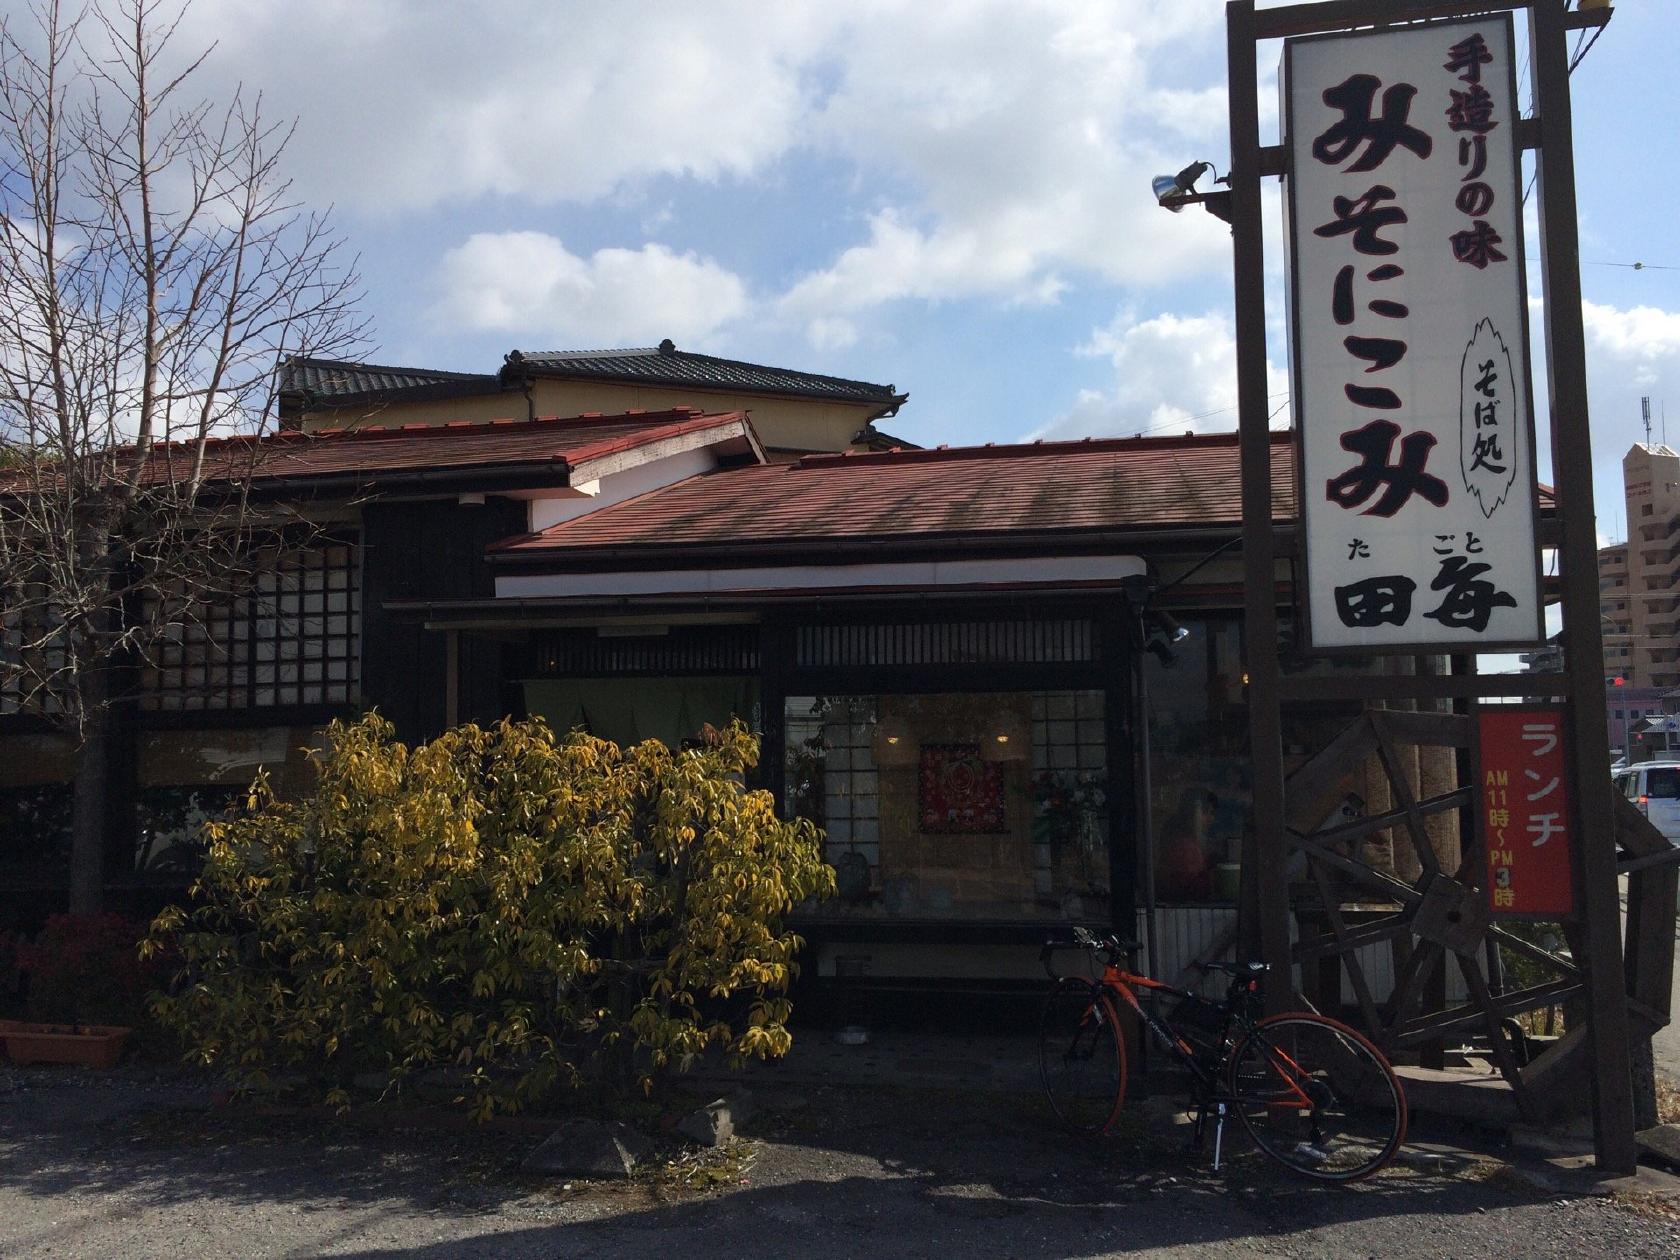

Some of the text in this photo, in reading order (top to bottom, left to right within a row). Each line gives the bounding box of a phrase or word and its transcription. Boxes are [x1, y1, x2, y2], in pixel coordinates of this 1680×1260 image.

[1443, 33, 1507, 269] 手造りの味
[1312, 74, 1449, 517] みそにこみ
[1470, 359, 1506, 474] そば処
[1334, 557, 1517, 632] 田毎
[1348, 539, 1370, 560] た
[1523, 723, 1565, 847] ランチ
